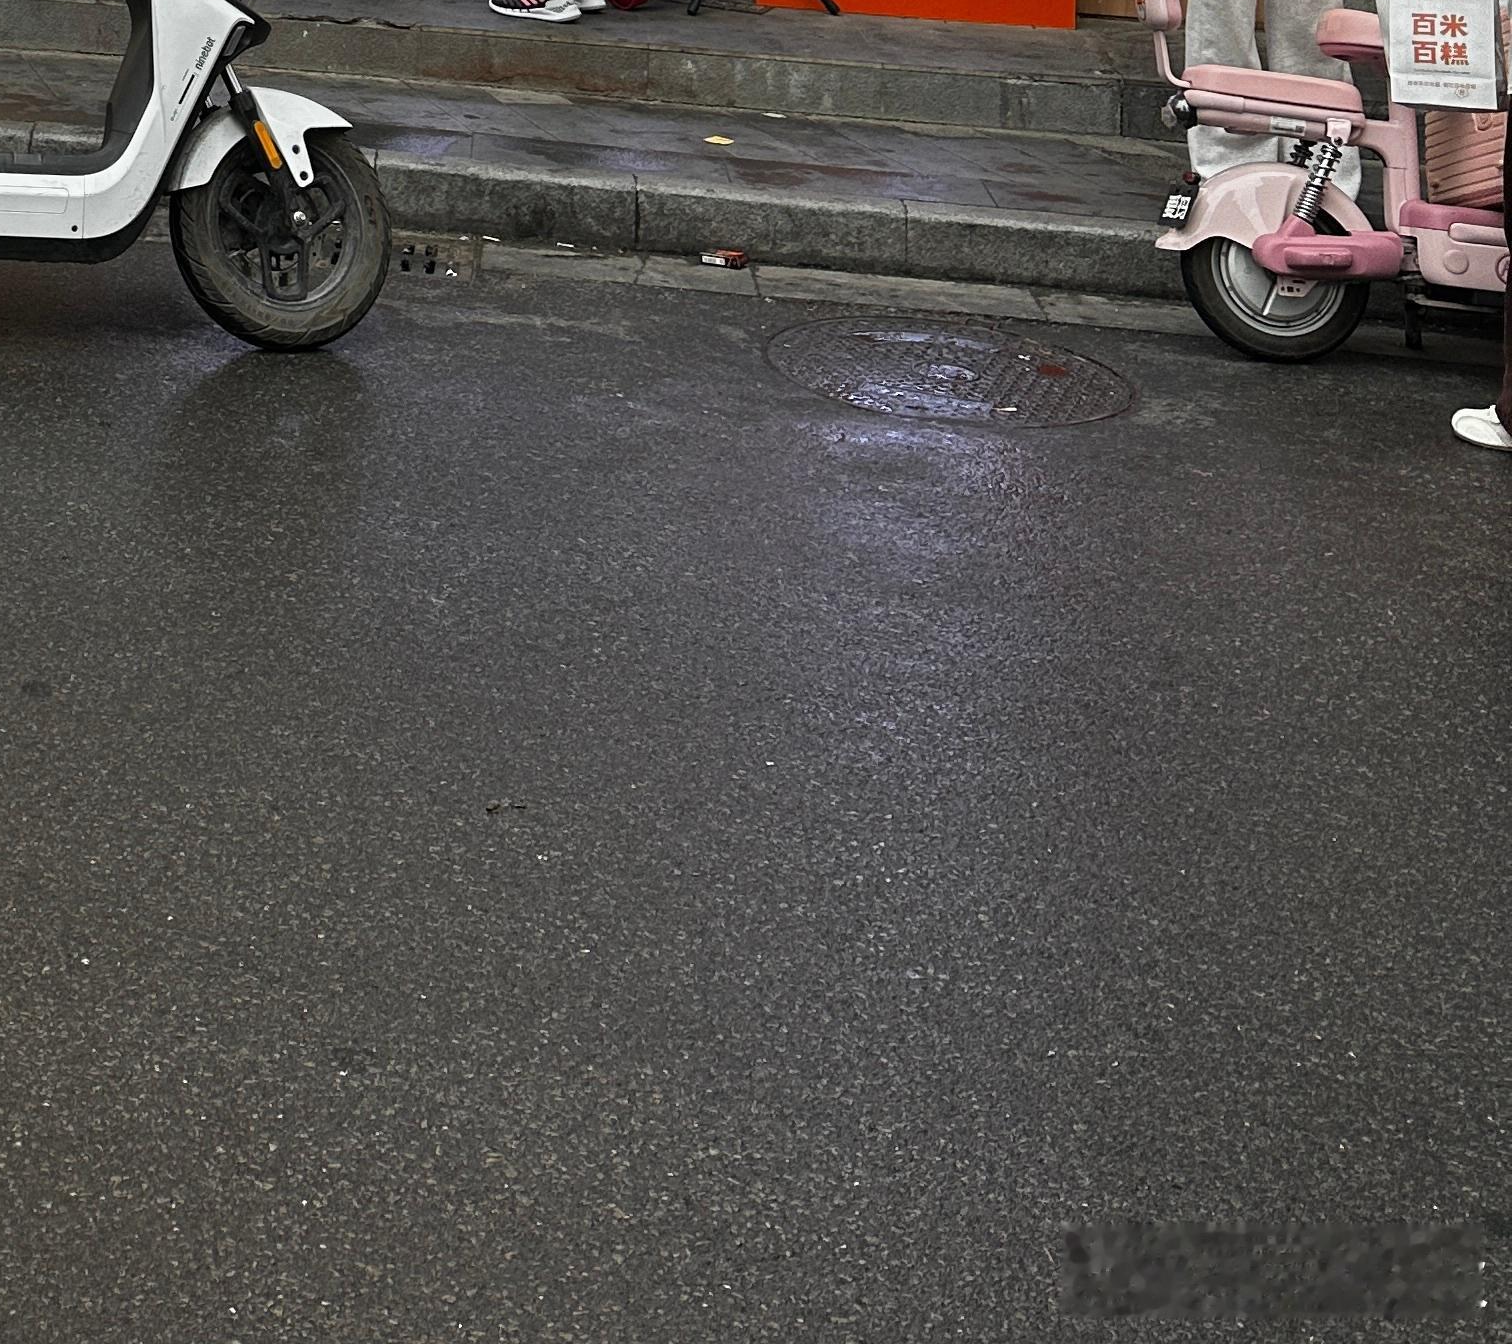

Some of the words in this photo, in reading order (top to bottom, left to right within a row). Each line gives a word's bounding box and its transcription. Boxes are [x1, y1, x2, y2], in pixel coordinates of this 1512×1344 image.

[1412, 13, 1469, 38] 百米
[195, 36, 217, 71] ninebot
[1412, 40, 1470, 66] 百糕
